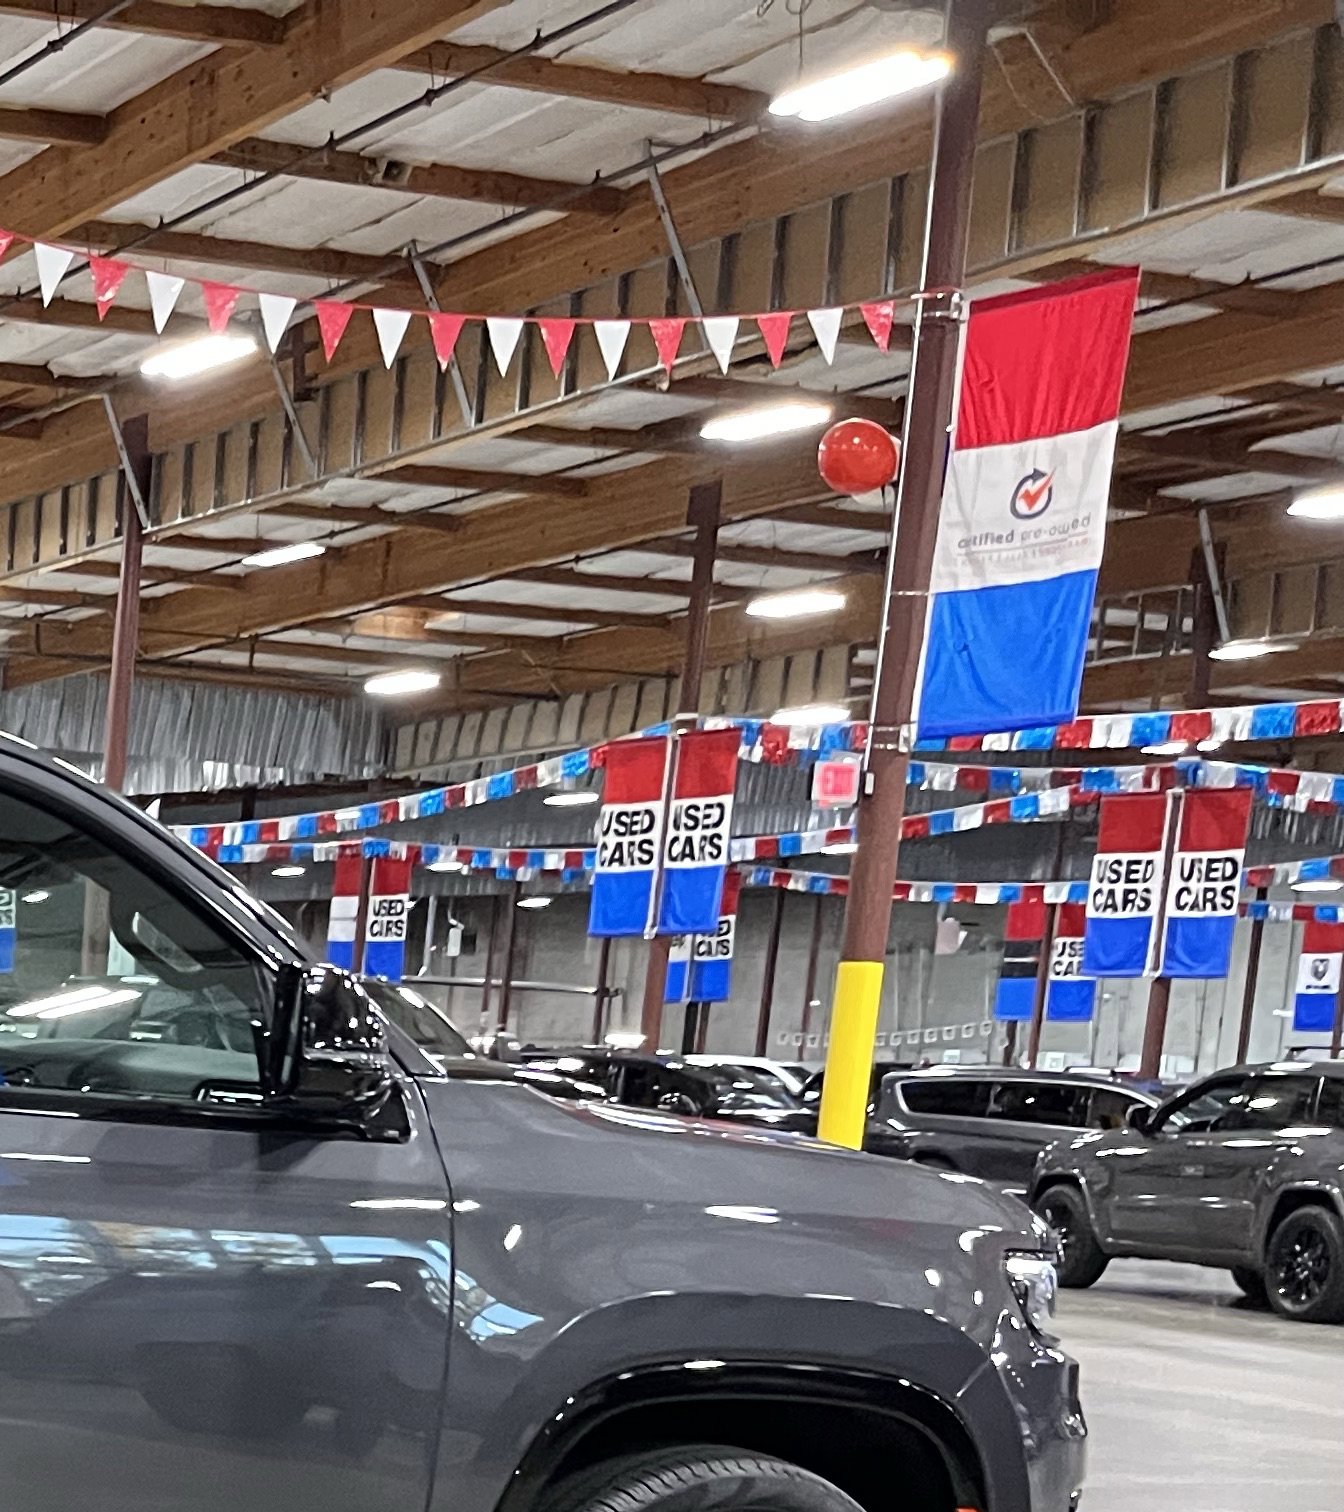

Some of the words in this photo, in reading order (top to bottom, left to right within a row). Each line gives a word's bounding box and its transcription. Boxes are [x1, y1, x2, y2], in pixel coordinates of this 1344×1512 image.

[601, 808, 656, 837] USED
[598, 838, 654, 867] CARS
[668, 833, 723, 862] CARS
[1096, 858, 1155, 884] USED
[1092, 887, 1152, 913] CARS
[1174, 885, 1236, 913] CARS
[369, 919, 405, 938] CRS
